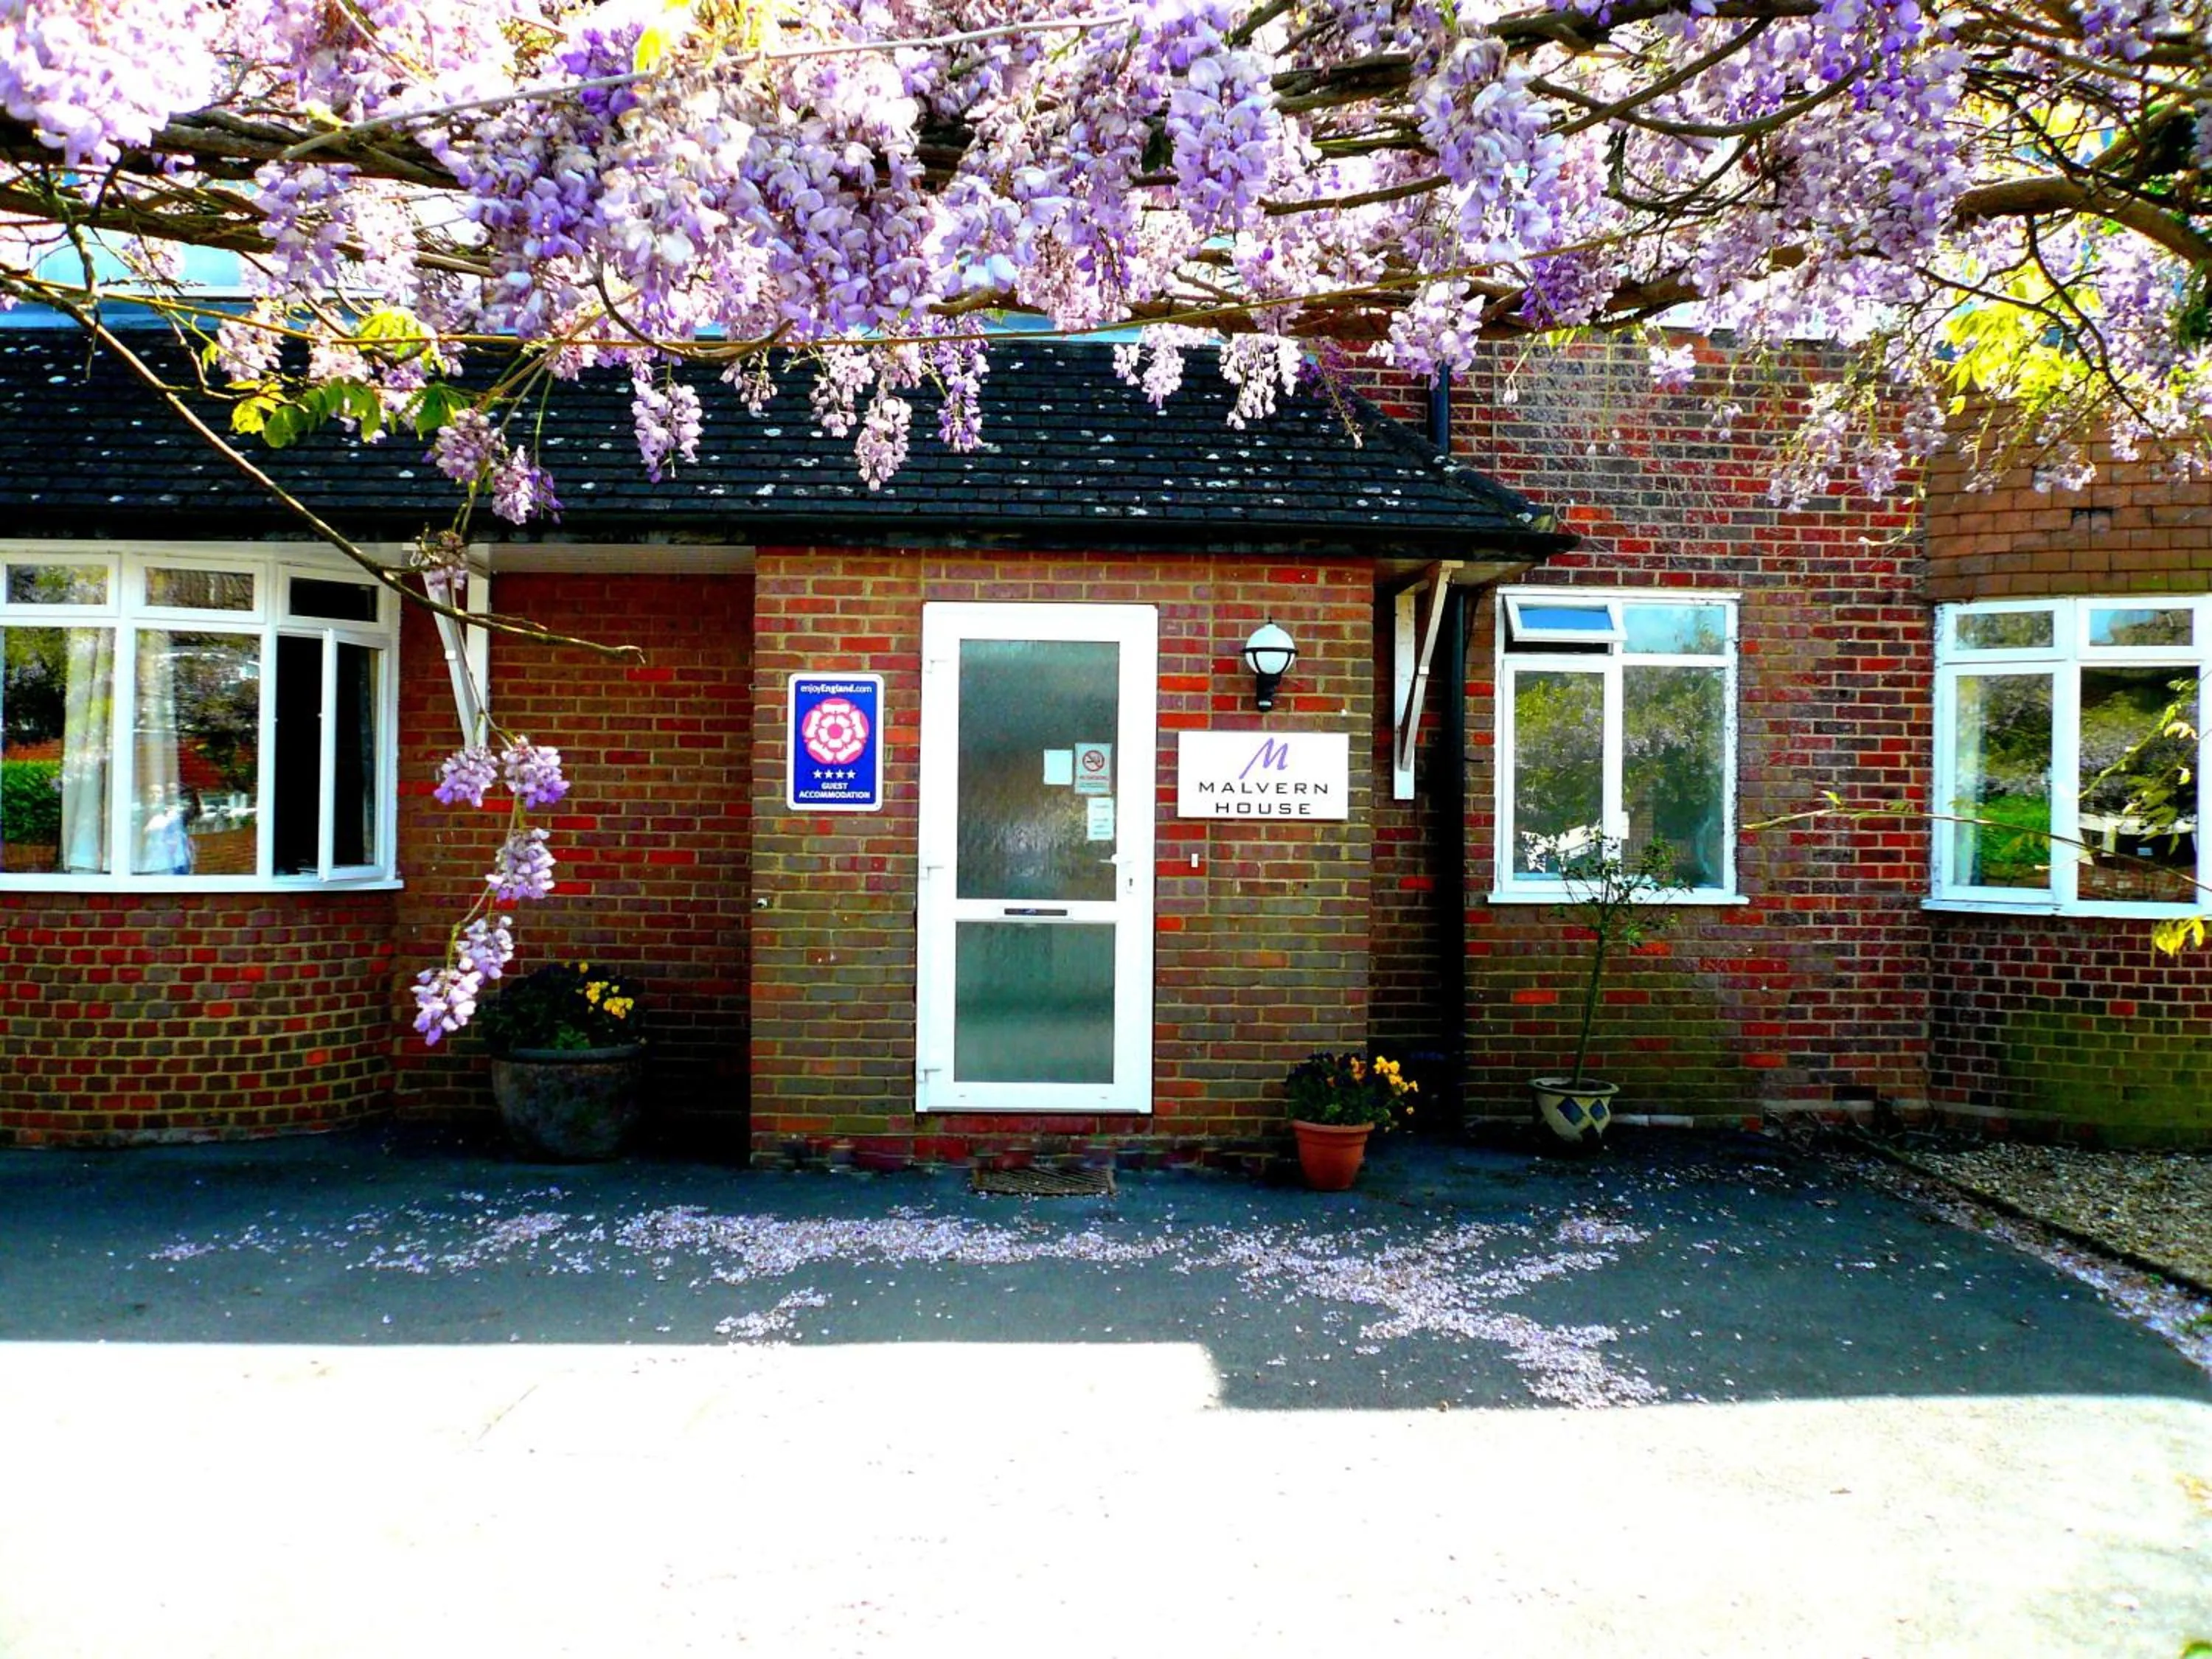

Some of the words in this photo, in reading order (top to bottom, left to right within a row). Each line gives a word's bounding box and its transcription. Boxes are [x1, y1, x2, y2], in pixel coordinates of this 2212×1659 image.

[800, 684, 872, 694] enjoyEngland.com
[1239, 737, 1288, 779] M
[1199, 782, 1328, 794] MALVERN
[1216, 802, 1311, 815] HOUSE
